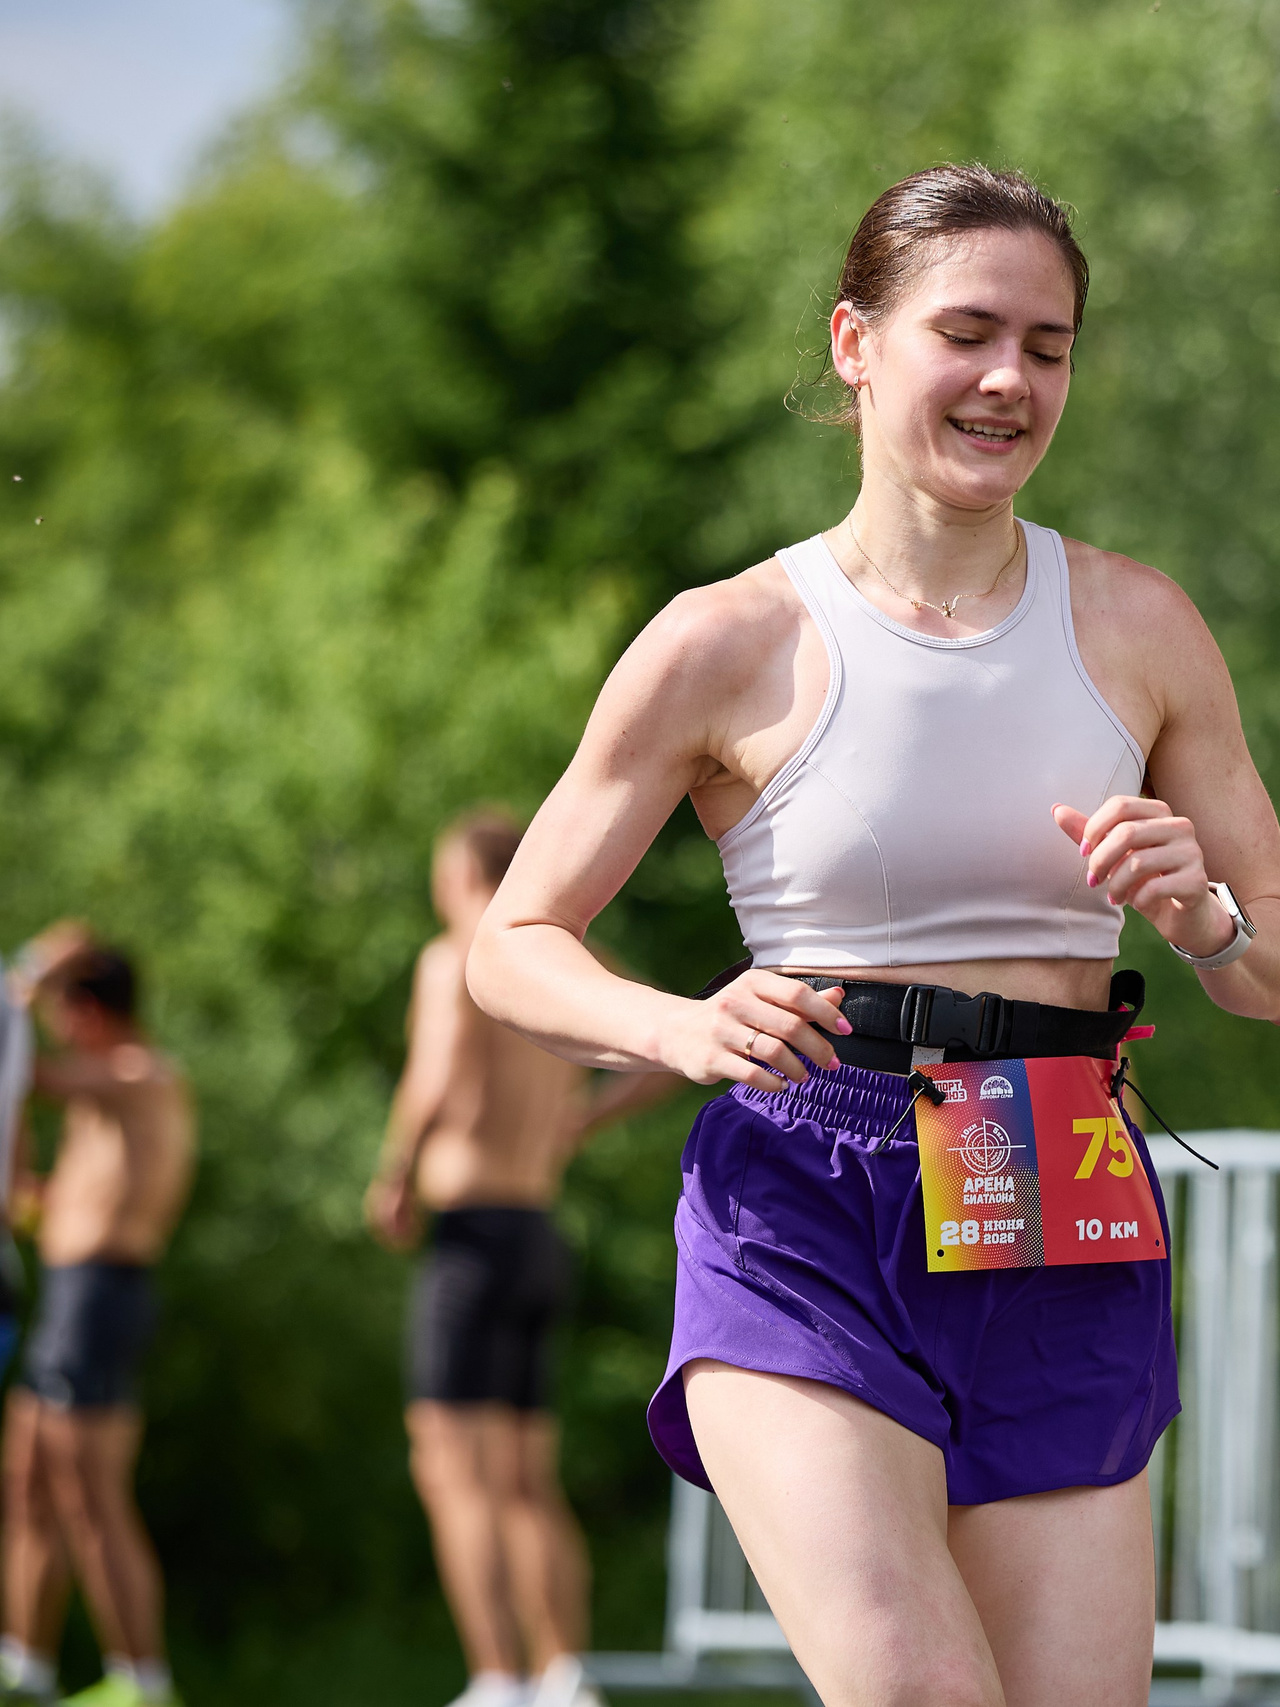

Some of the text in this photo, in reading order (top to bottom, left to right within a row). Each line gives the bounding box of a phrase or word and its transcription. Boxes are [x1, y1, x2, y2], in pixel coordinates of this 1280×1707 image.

[936, 1081, 960, 1092] ПОРТ
[1072, 1116, 1134, 1179] 75
[963, 1175, 1015, 1193] АРЕНА
[963, 1192, 1015, 1205] БИАТЛОНА
[940, 1219, 1025, 1246] 28 ИЮНЯ
[1075, 1218, 1104, 1241] 10
